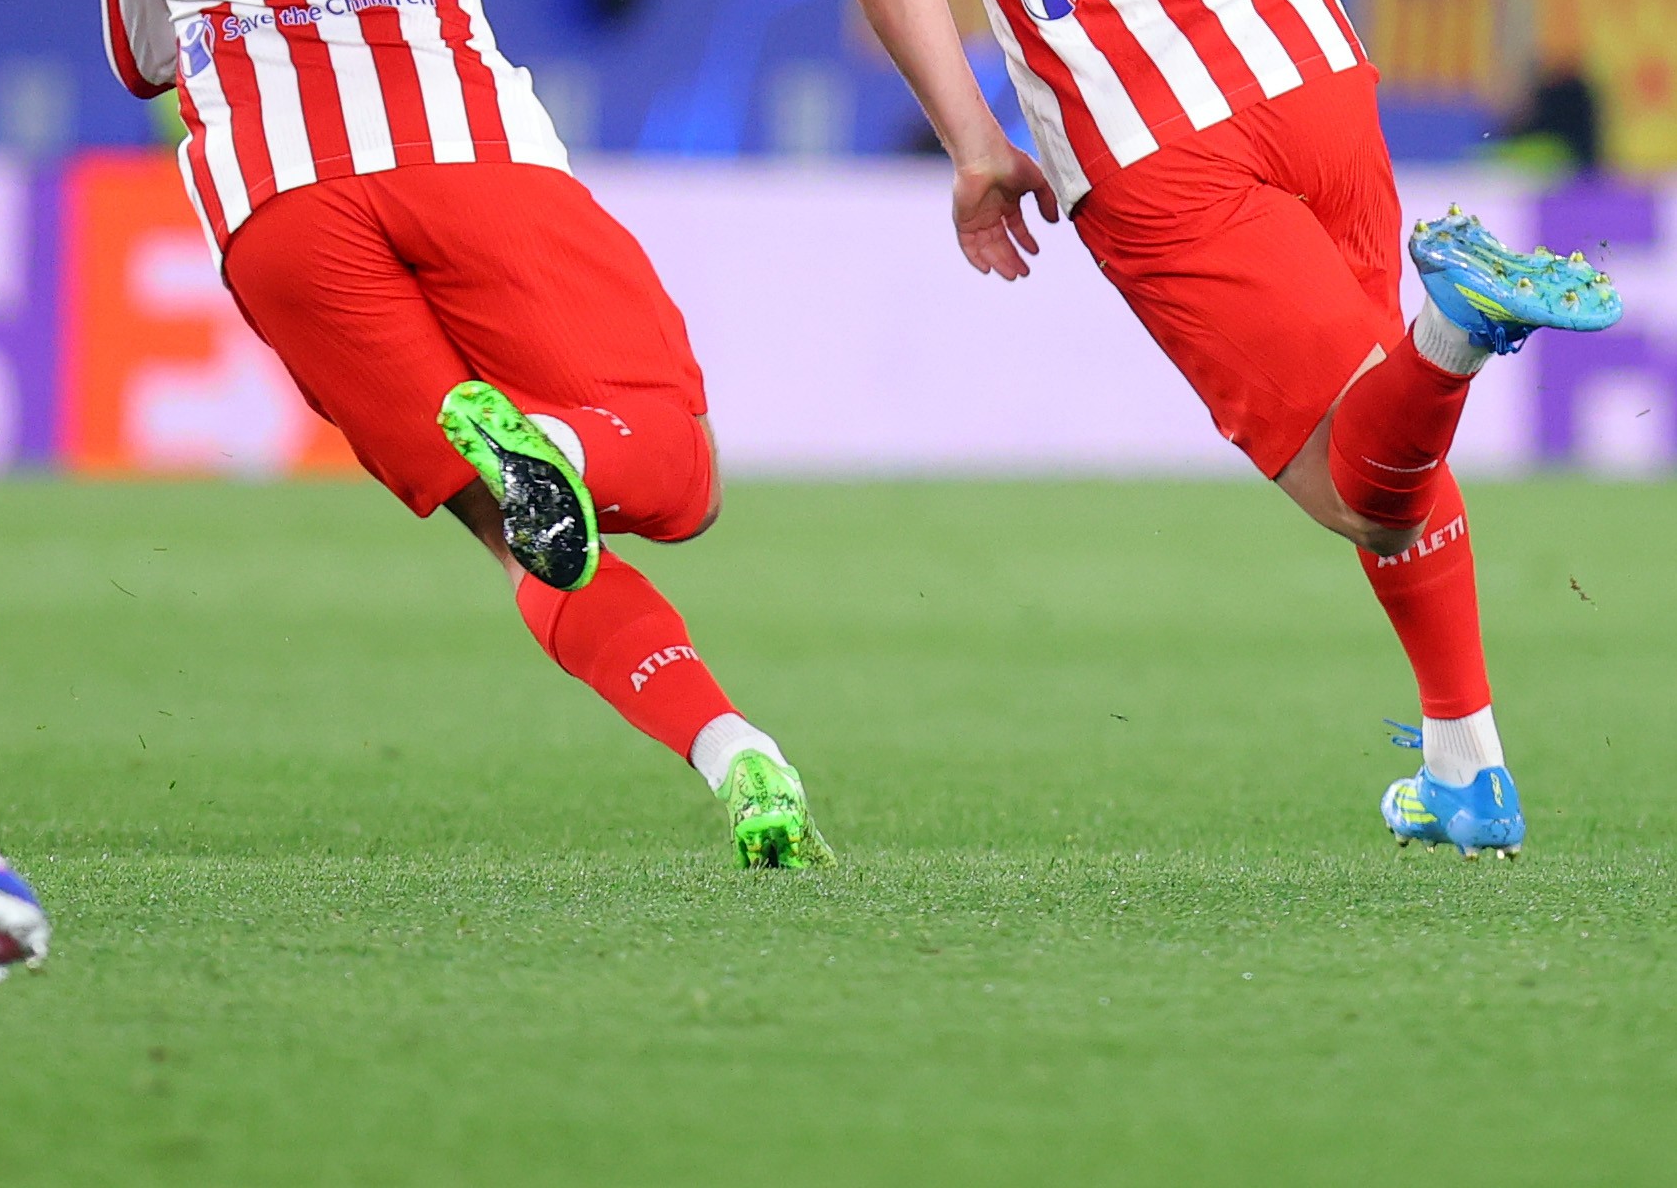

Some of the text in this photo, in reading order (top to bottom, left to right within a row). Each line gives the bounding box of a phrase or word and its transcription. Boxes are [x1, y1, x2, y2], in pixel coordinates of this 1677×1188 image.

[223, 14, 274, 40] Save
[281, 6, 323, 26] the
[630, 645, 700, 693] ATLETI
